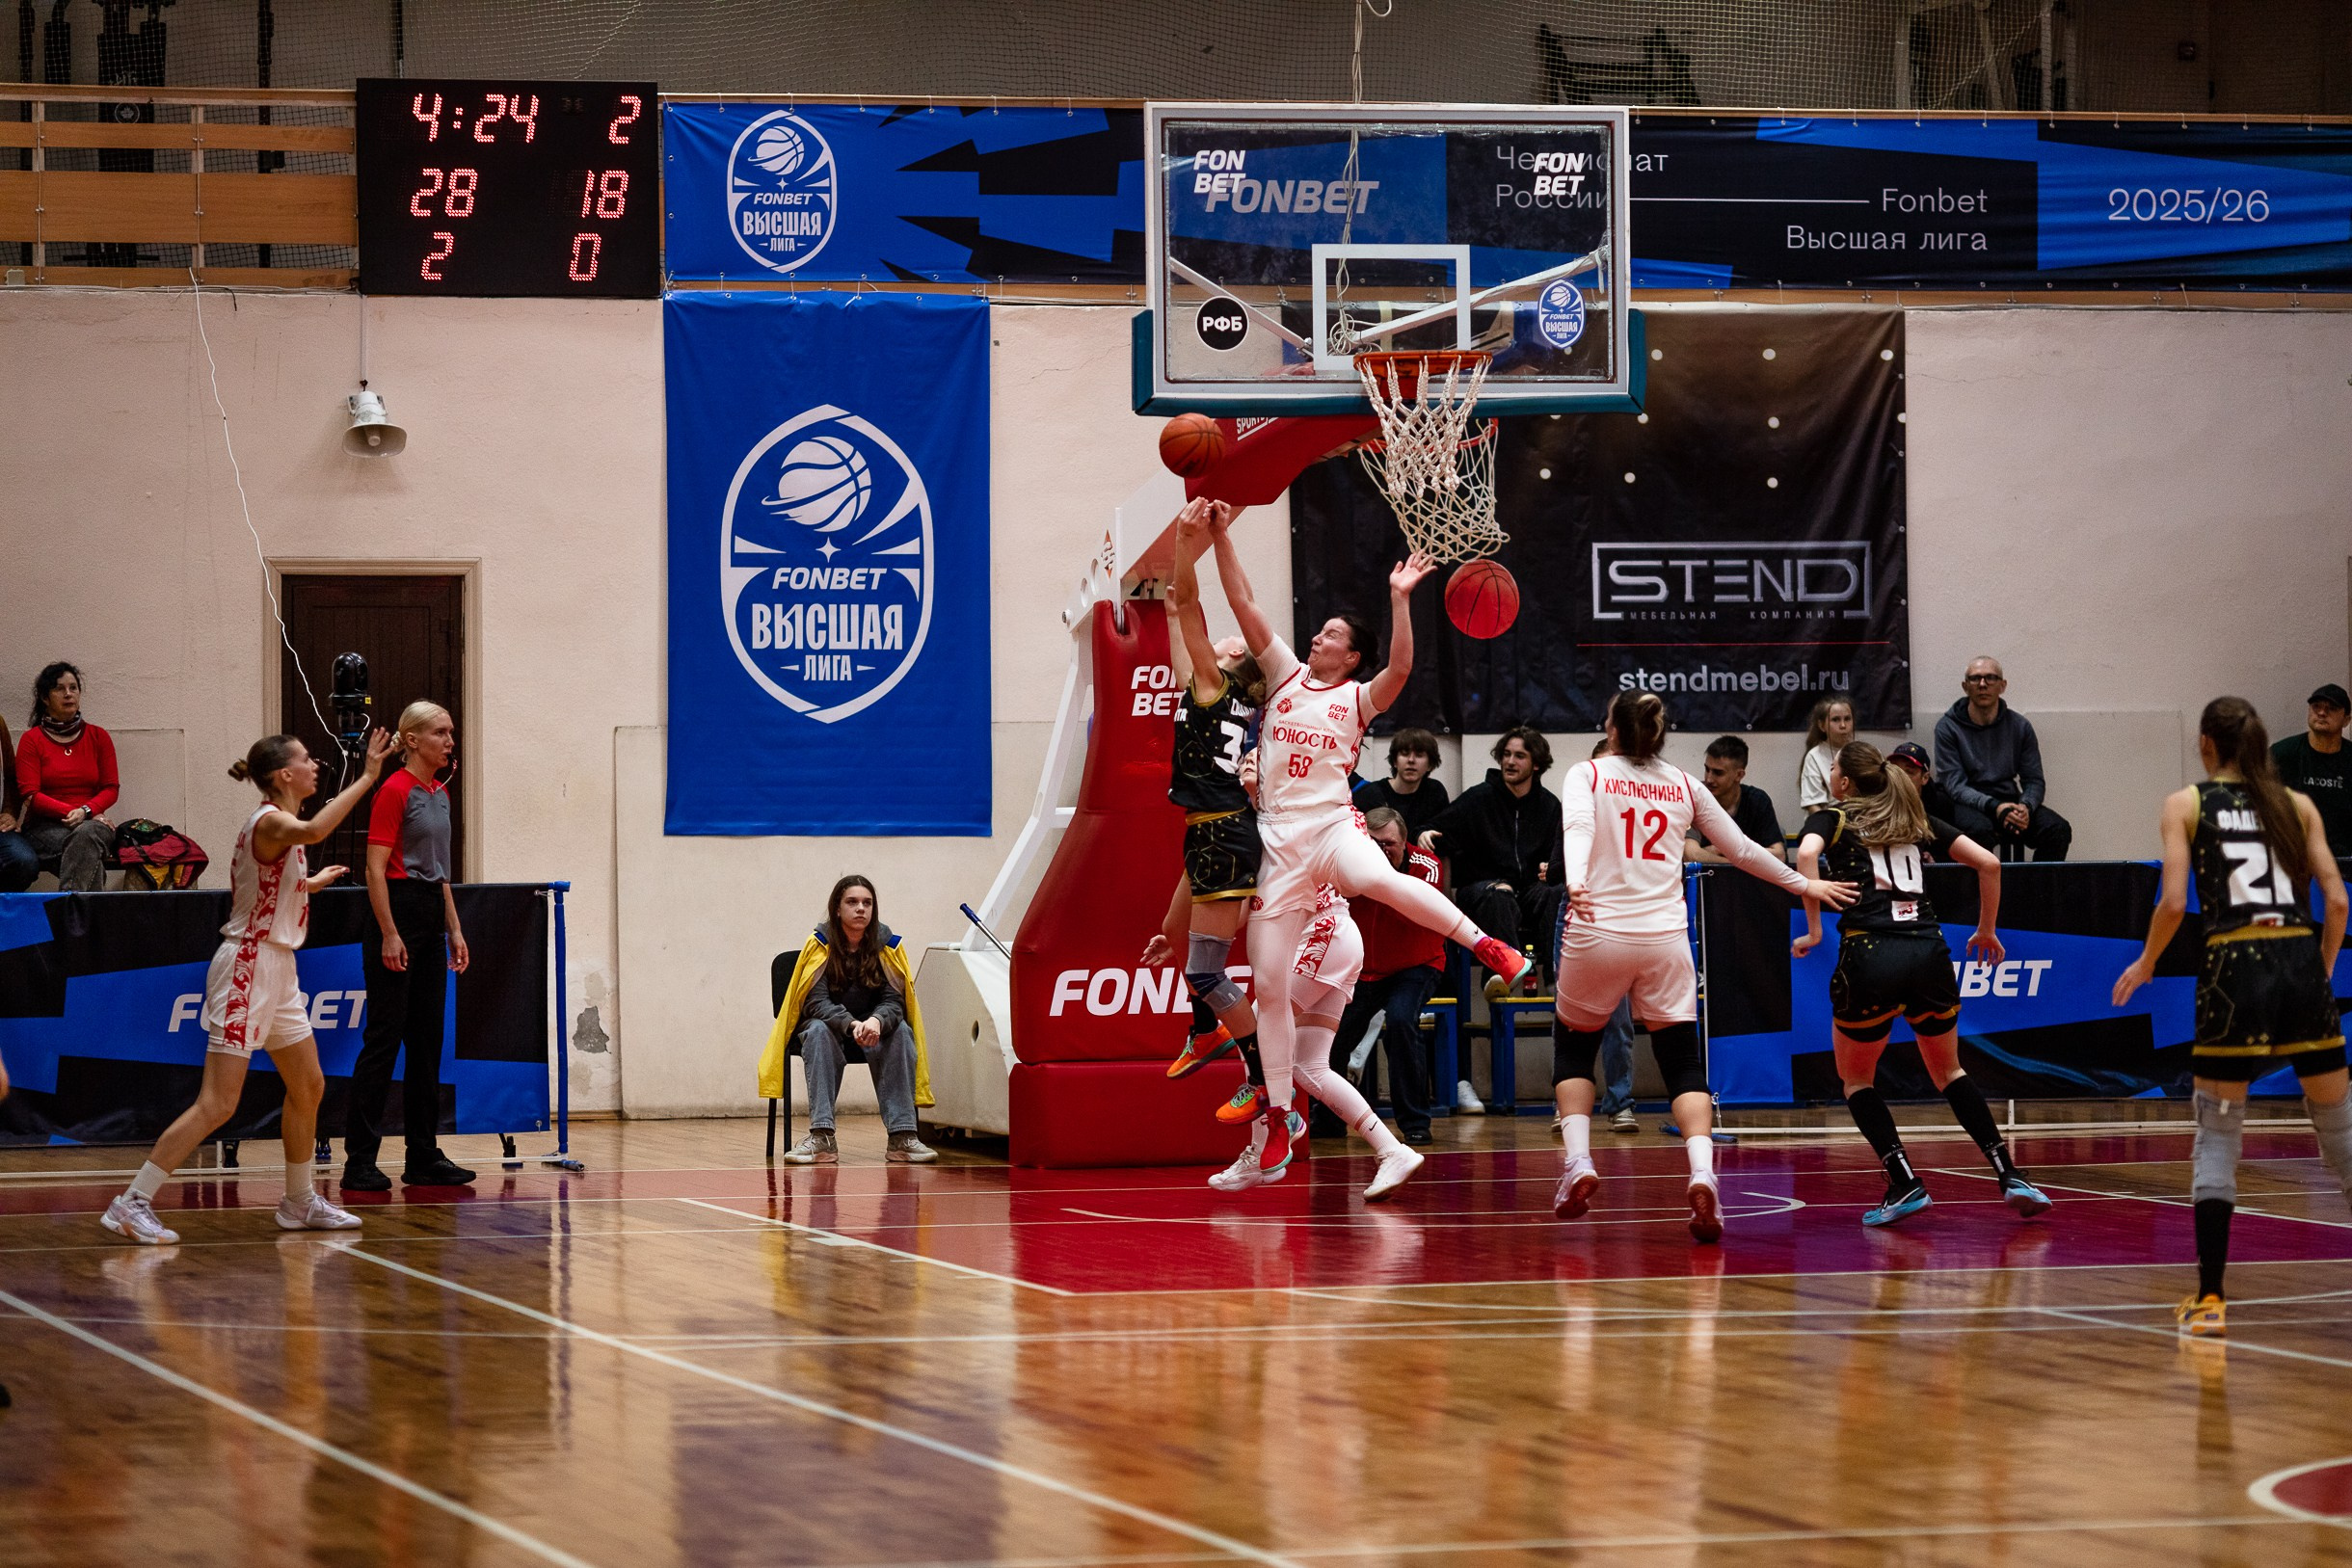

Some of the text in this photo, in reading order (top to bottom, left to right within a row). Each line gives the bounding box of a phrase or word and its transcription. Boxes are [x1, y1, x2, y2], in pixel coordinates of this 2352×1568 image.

[413, 93, 539, 143] 4:24
[609, 96, 641, 144] 2
[1193, 150, 1245, 171] FON
[1534, 152, 1585, 173] FON
[411, 169, 478, 217] 28
[581, 171, 628, 218] 18
[1194, 173, 1245, 194] BET
[1534, 175, 1585, 196] BET
[754, 193, 813, 205] FONBET
[1205, 180, 1379, 214] FONBET
[1882, 188, 1988, 213] Fonbet
[2107, 188, 2271, 224] 2025/26
[743, 211, 821, 235] ВЫСШАЯ
[769, 237, 795, 252] ЛИГА
[1786, 226, 1988, 251] Высшая лига
[421, 232, 454, 279] 2
[569, 233, 601, 280] 0
[1202, 316, 1243, 332] РФБ
[1545, 322, 1578, 332] ВЫСШАЯ
[771, 568, 888, 590] FONBET
[1609, 559, 1860, 602] STEND
[751, 603, 903, 651] ВЫСШАЯ
[1630, 609, 1836, 621] МЕБЕЛЬНАЯ КОМПАНИЯ
[803, 654, 852, 680] ЛИГА
[1618, 664, 1850, 692] stendmebel.ru
[1327, 711, 1348, 722] BET
[1329, 704, 1350, 714] FON
[1214, 720, 1247, 775] 3
[1272, 726, 1337, 750] ЮНОСТЬ
[1288, 753, 1313, 779] 58
[1603, 778, 1685, 804] КИСЛЮНИНА
[2303, 776, 2343, 789] LACOSTE
[1620, 807, 1669, 862] 12
[1868, 843, 1923, 894] 10
[2221, 841, 2295, 907] 21
